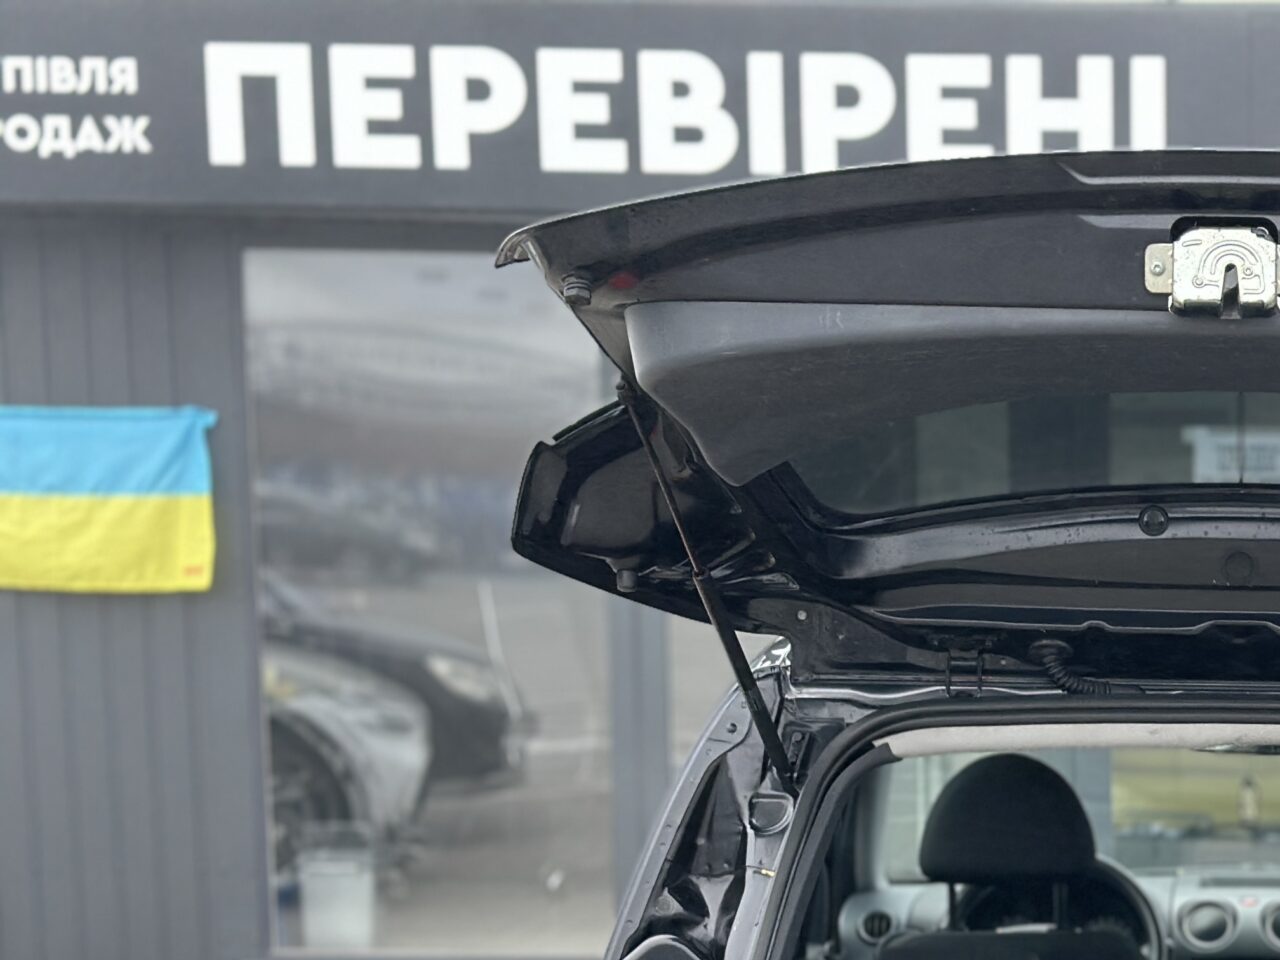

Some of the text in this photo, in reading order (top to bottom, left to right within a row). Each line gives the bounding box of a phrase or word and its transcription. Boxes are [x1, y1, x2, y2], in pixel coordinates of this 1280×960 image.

[1, 55, 138, 95] ПІВЛЯ
[203, 41, 1168, 175] ПЕРЕВІРЕНІ
[0, 112, 152, 159] ОДАЖ
